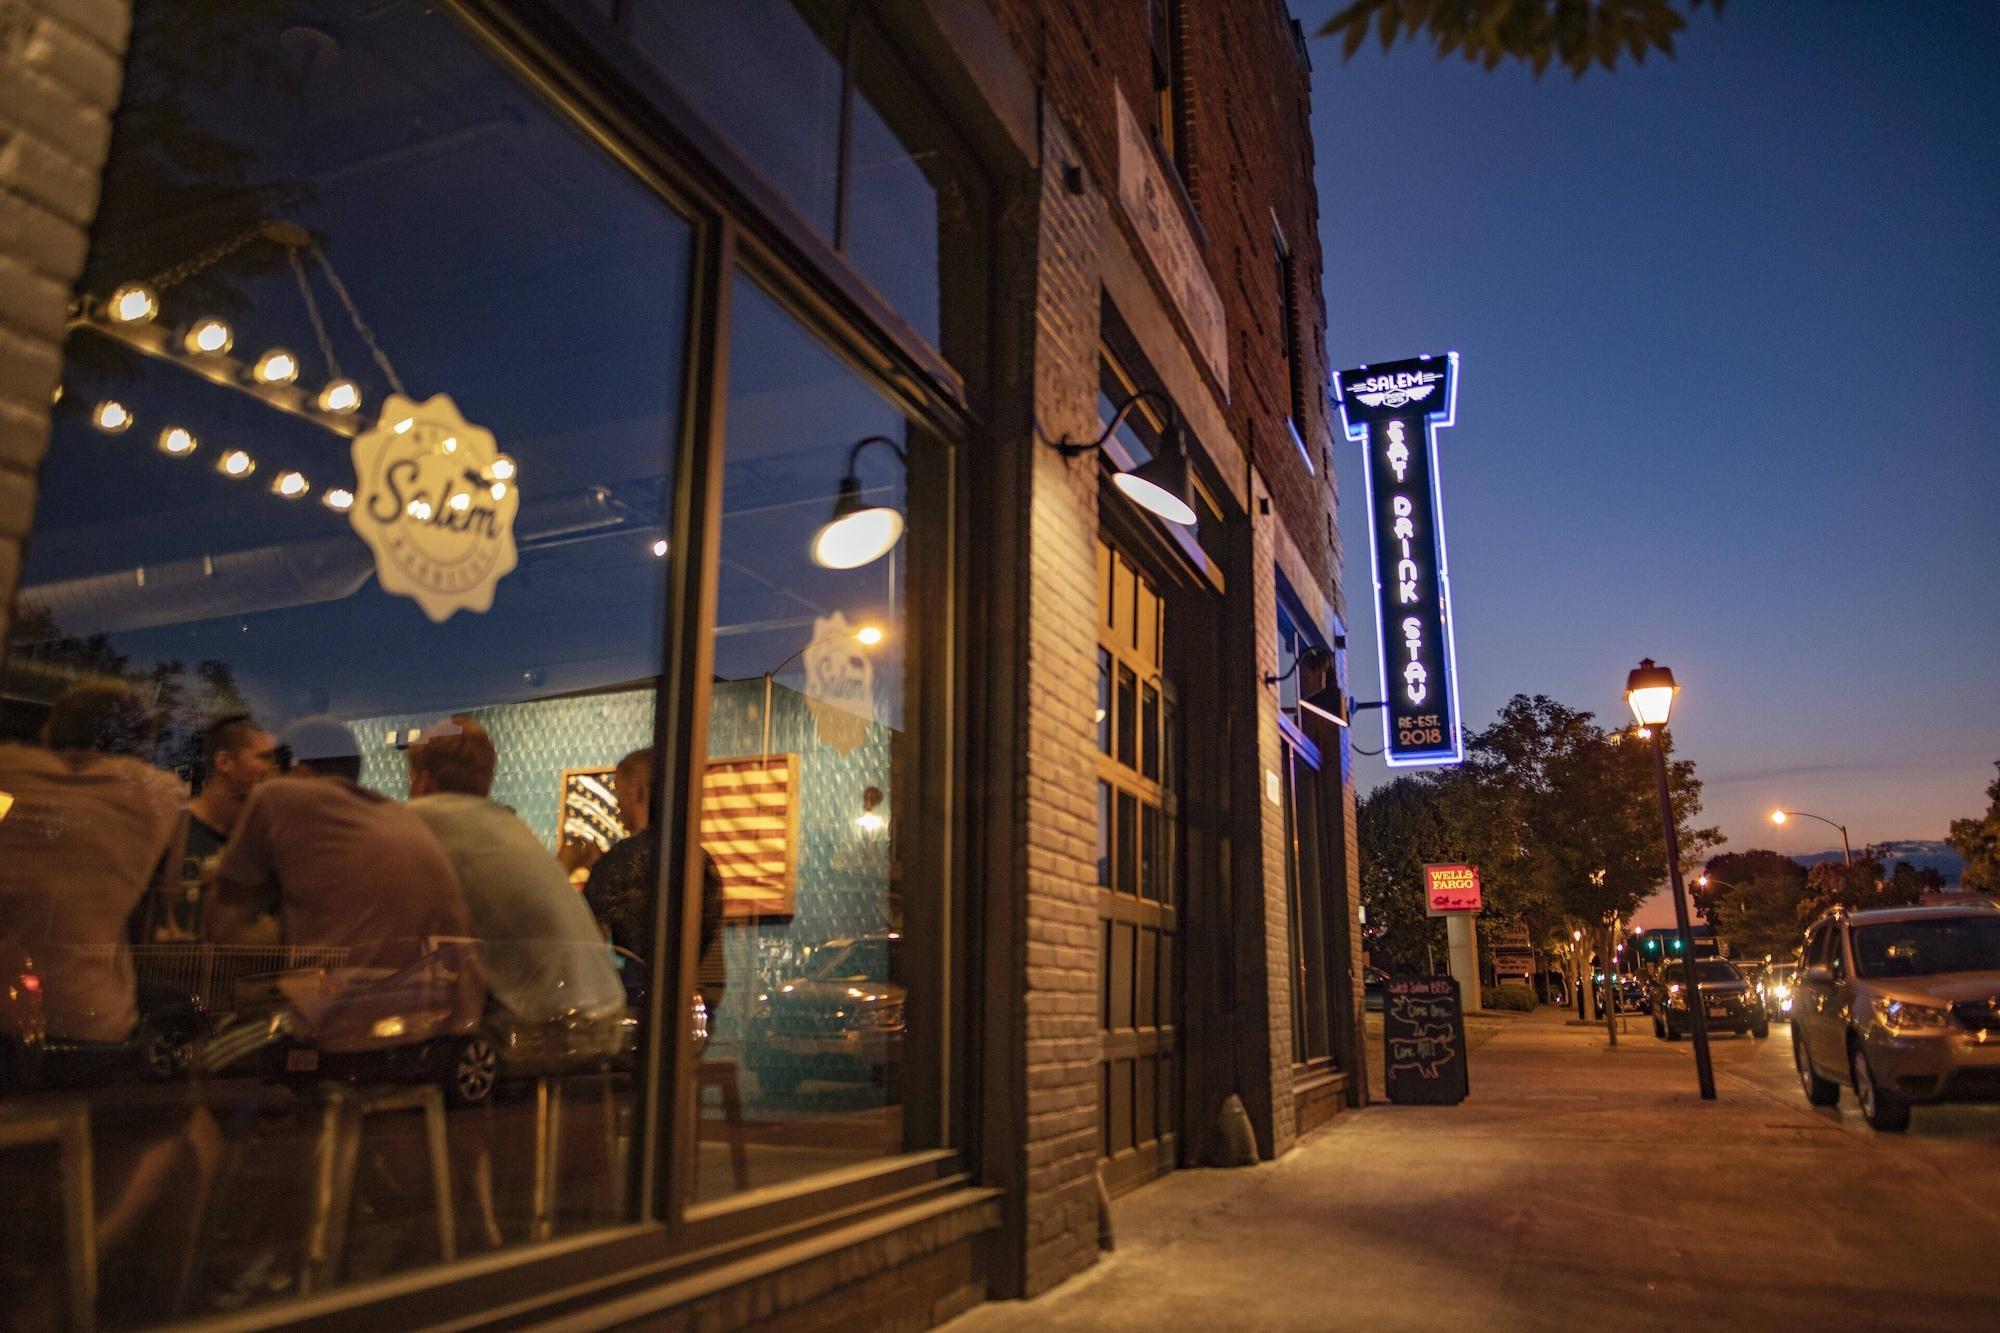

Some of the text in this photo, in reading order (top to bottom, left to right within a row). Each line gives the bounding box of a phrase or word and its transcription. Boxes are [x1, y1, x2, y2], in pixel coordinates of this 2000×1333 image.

[1366, 371, 1423, 393] SALEM
[1386, 420, 1409, 483] EAT
[1394, 496, 1418, 604] DRINK
[1402, 617, 1427, 706] STAY
[1398, 714, 1441, 729] RE-EST.
[1400, 728, 1442, 745] 2018
[1431, 870, 1473, 881] WELLS
[1432, 879, 1473, 890] FARGO
